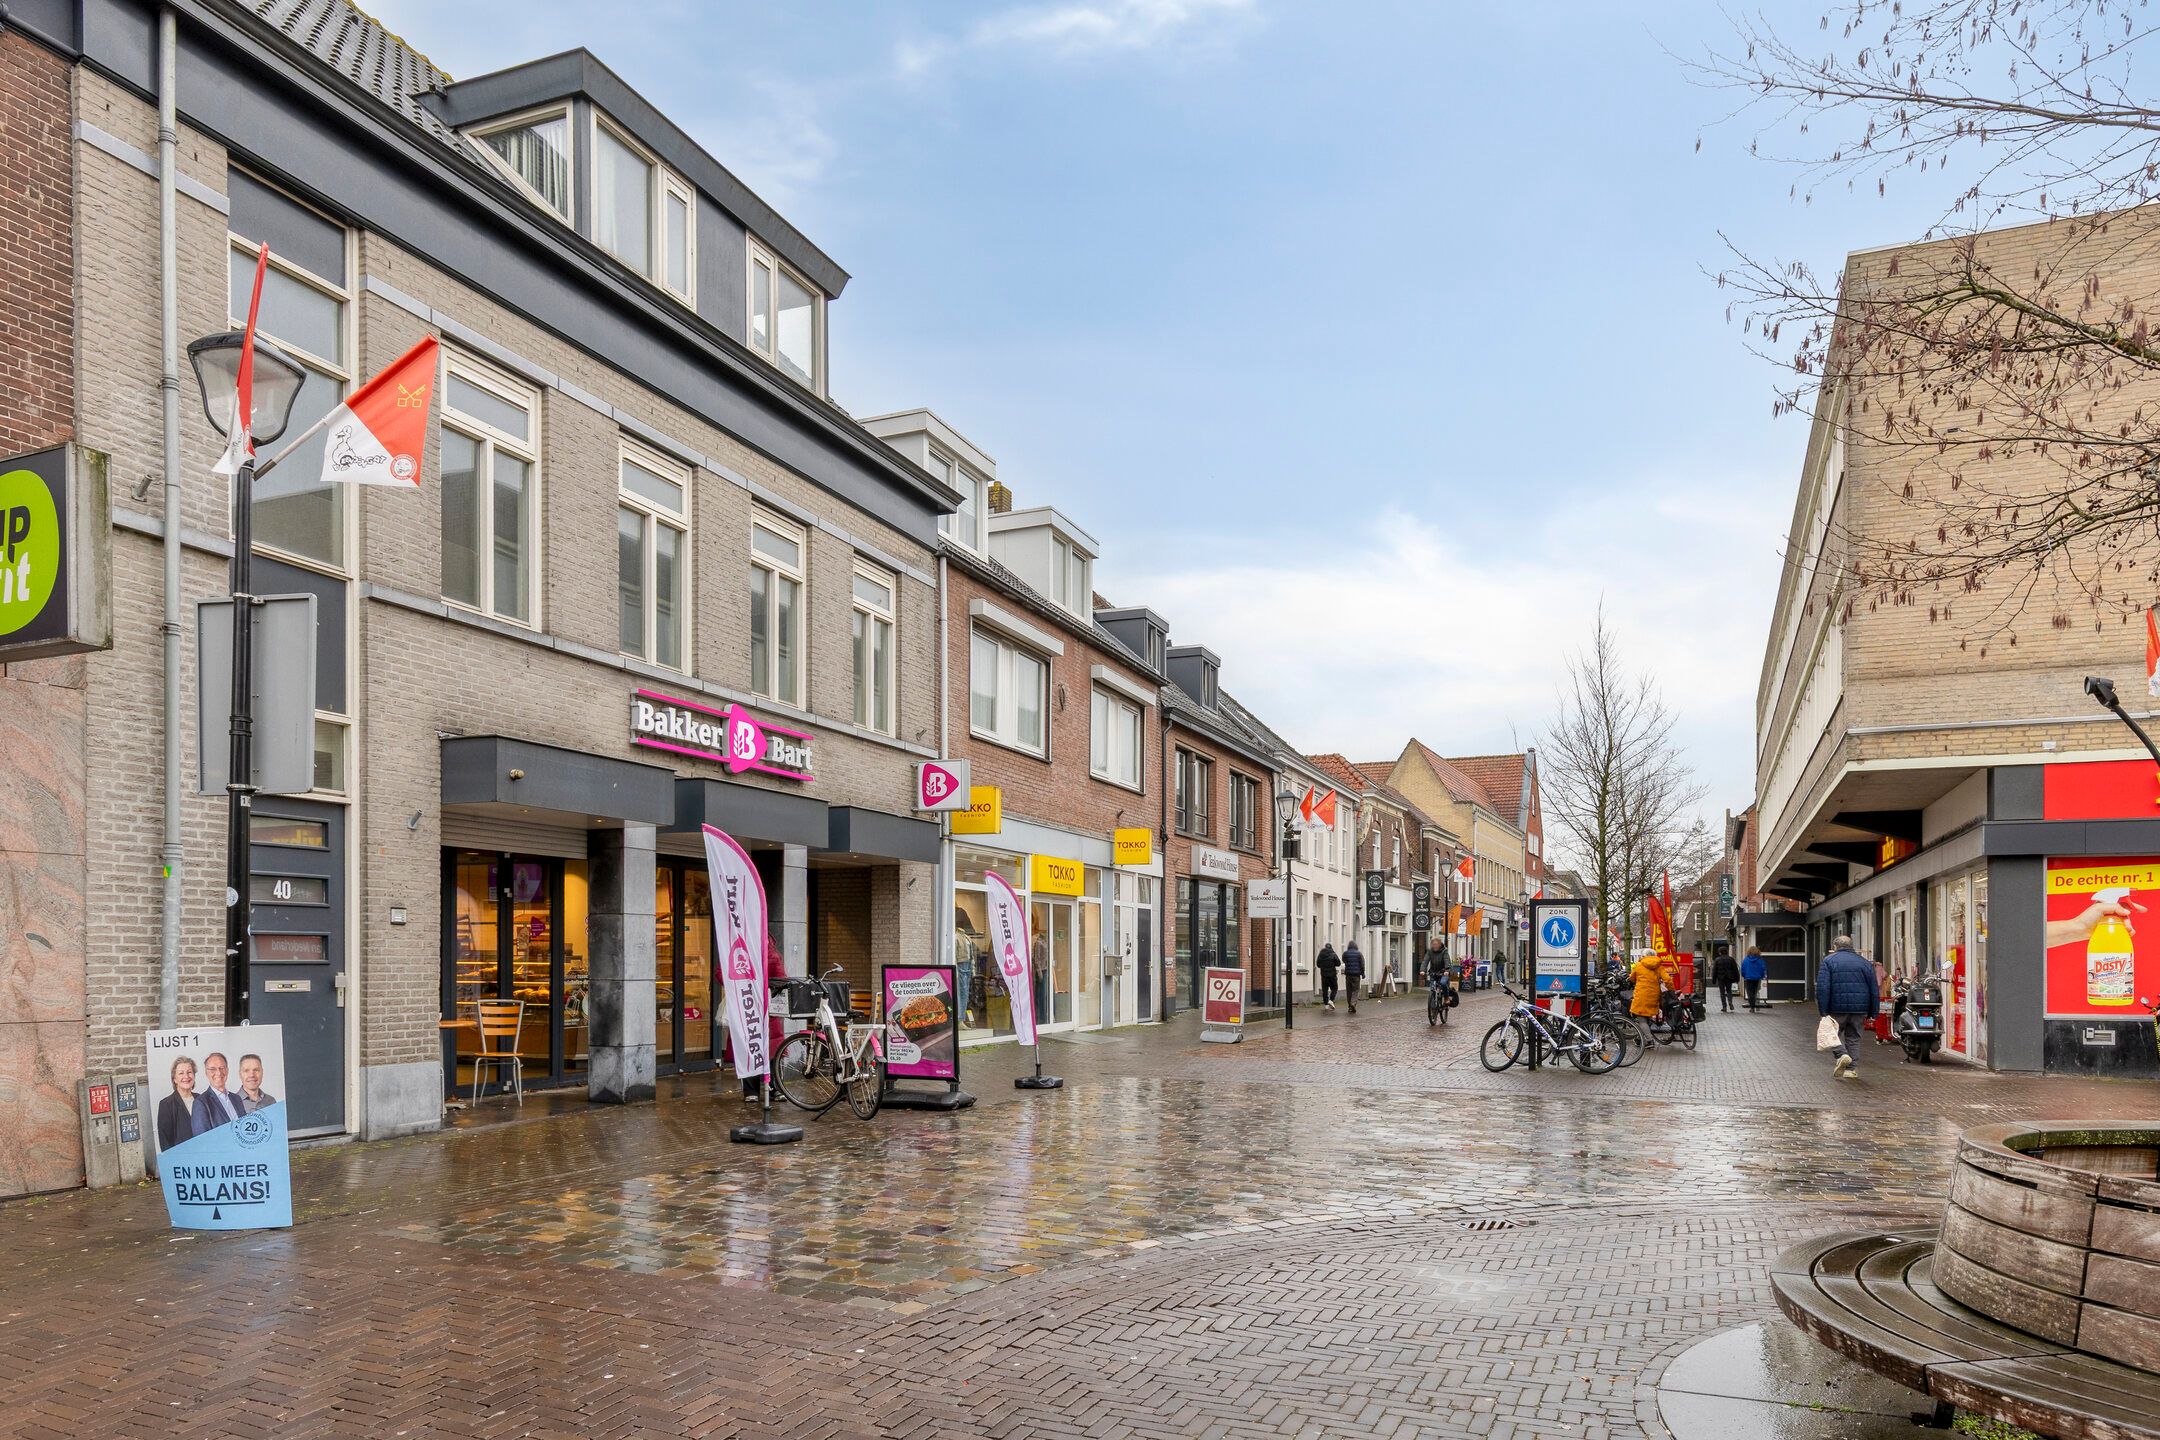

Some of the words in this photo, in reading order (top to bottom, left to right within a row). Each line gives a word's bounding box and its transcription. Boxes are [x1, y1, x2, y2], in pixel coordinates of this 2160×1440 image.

[638, 701, 723, 749] Bakker
[772, 736, 813, 771] Bart
[1226, 858, 1238, 873] House
[2055, 876, 2073, 887] De
[2077, 874, 2118, 886] echte
[2123, 873, 2142, 884] nr.
[2146, 871, 2154, 882] 1
[273, 880, 292, 900] 40
[998, 903, 1012, 940] Bart
[2095, 960, 2126, 973] Dasty
[900, 981, 922, 990] vliegen
[741, 983, 766, 1071] Bakker
[153, 1035, 189, 1048] LIJST
[193, 1035, 199, 1047] 1
[244, 1121, 259, 1133] 20
[173, 1166, 192, 1180] EN
[195, 1165, 216, 1179] NU
[221, 1164, 269, 1178] MEER
[175, 1181, 271, 1202] BALANS!
